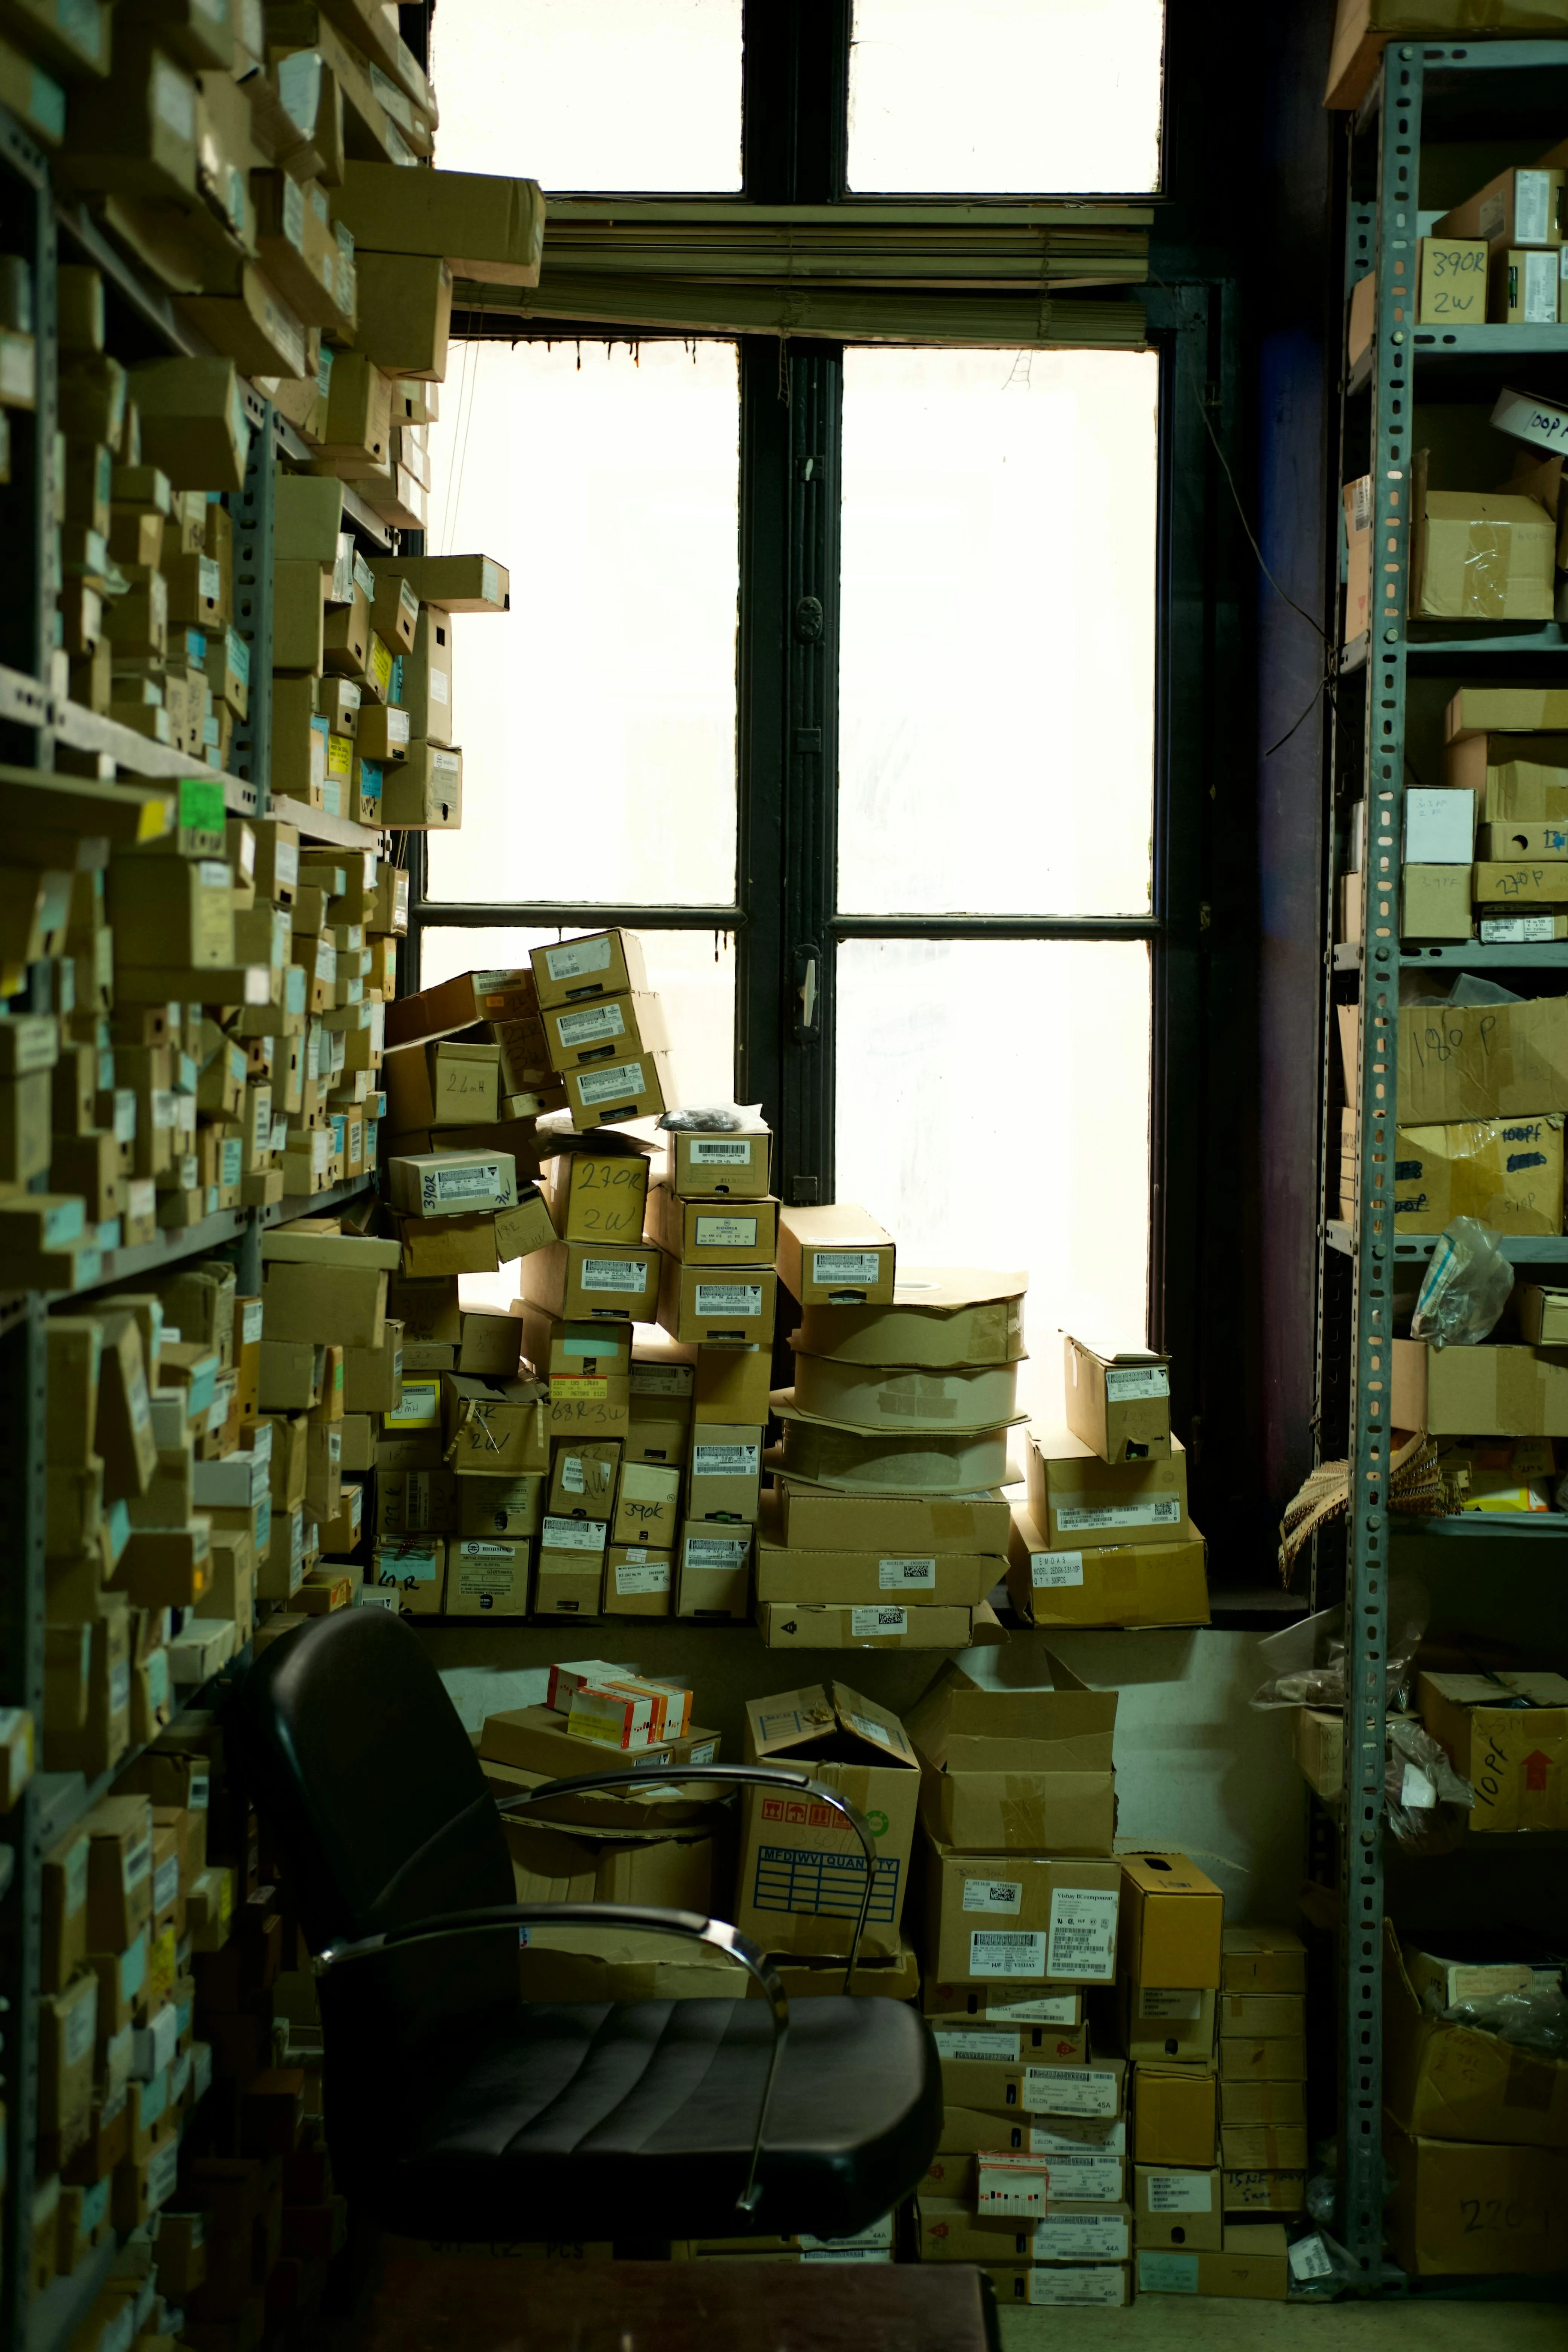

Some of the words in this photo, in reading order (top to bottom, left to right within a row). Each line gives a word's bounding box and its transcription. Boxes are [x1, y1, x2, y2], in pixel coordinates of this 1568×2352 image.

[1433, 251, 1485, 277] 390R
[578, 1163, 642, 1191] 270R
[423, 1173, 438, 1209] 390R
[764, 1849, 792, 1861] MFD
[798, 1853, 818, 1863] WV
[827, 1856, 894, 1870] QUANTY
